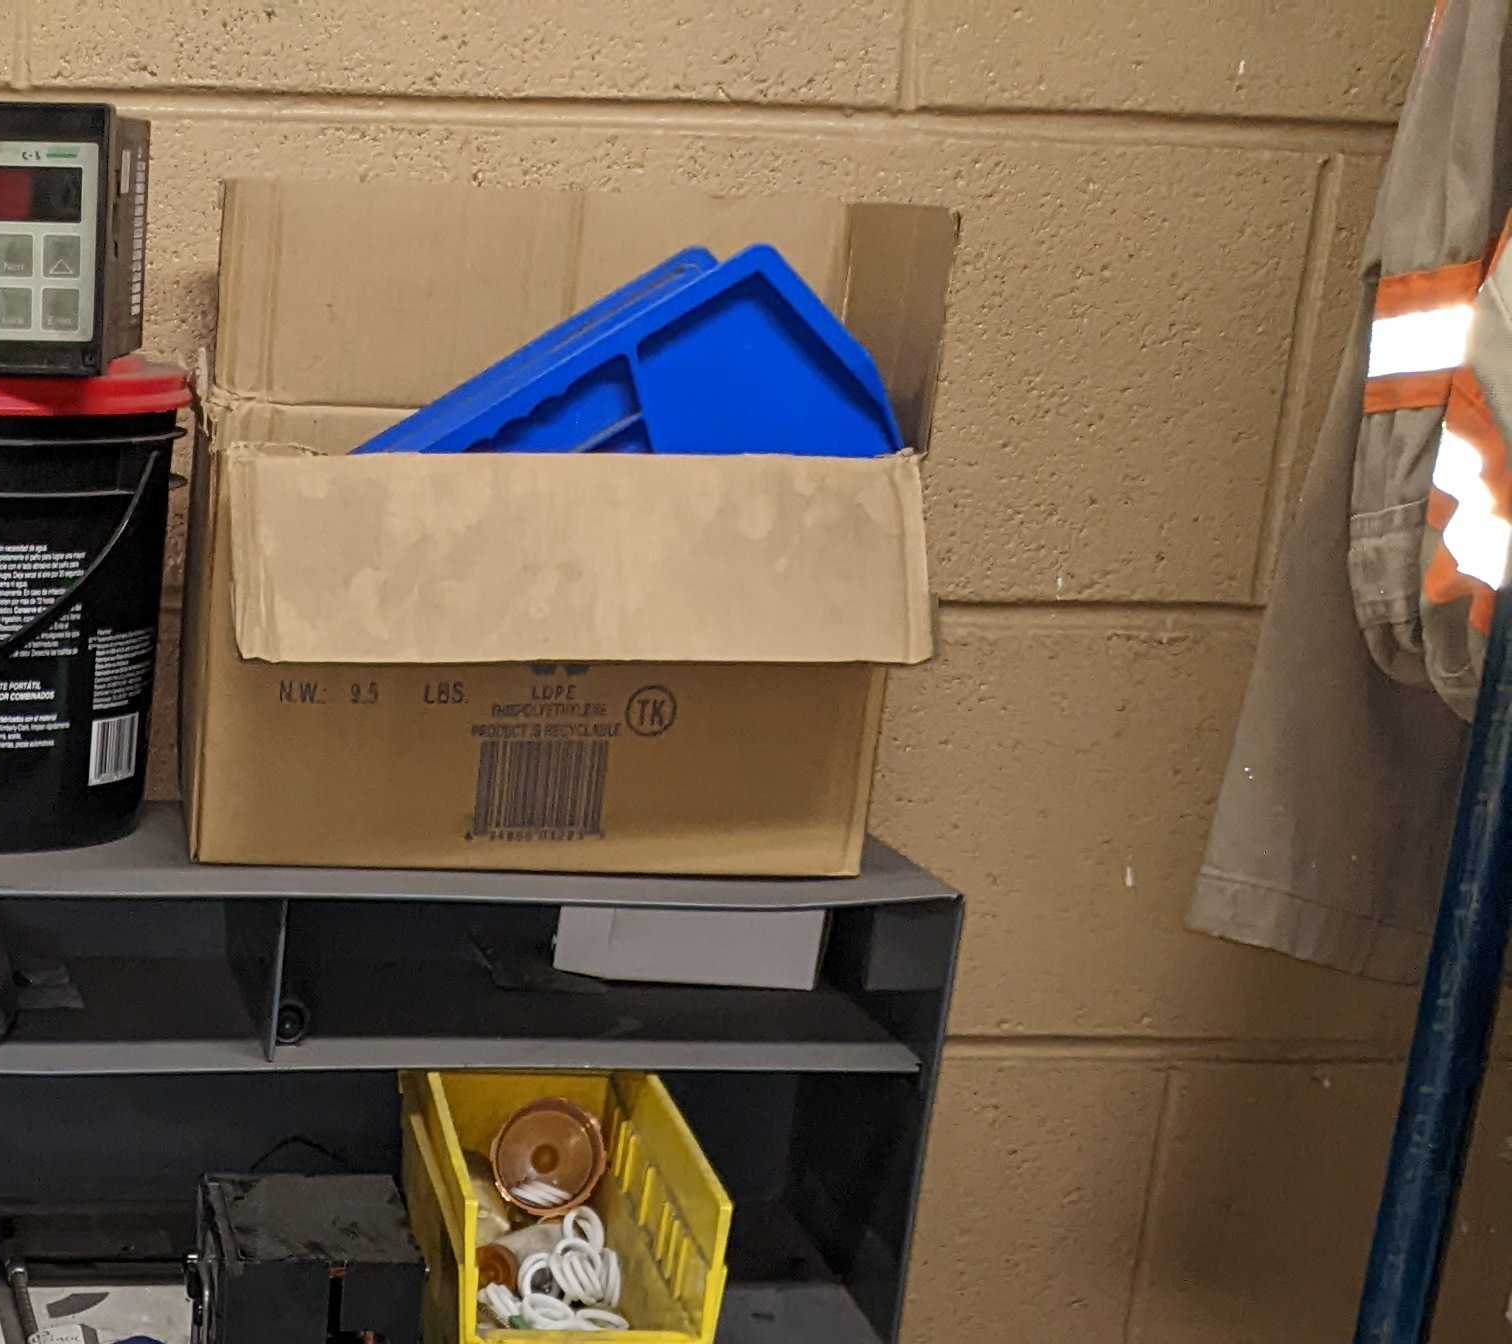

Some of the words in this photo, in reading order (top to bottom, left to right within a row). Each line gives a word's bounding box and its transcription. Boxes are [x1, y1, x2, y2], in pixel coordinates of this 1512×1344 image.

[9, 680, 41, 689] PORTÁTIL
[10, 691, 55, 700] COMBINADOS
[531, 684, 577, 700] LDPE
[637, 698, 665, 726] TK
